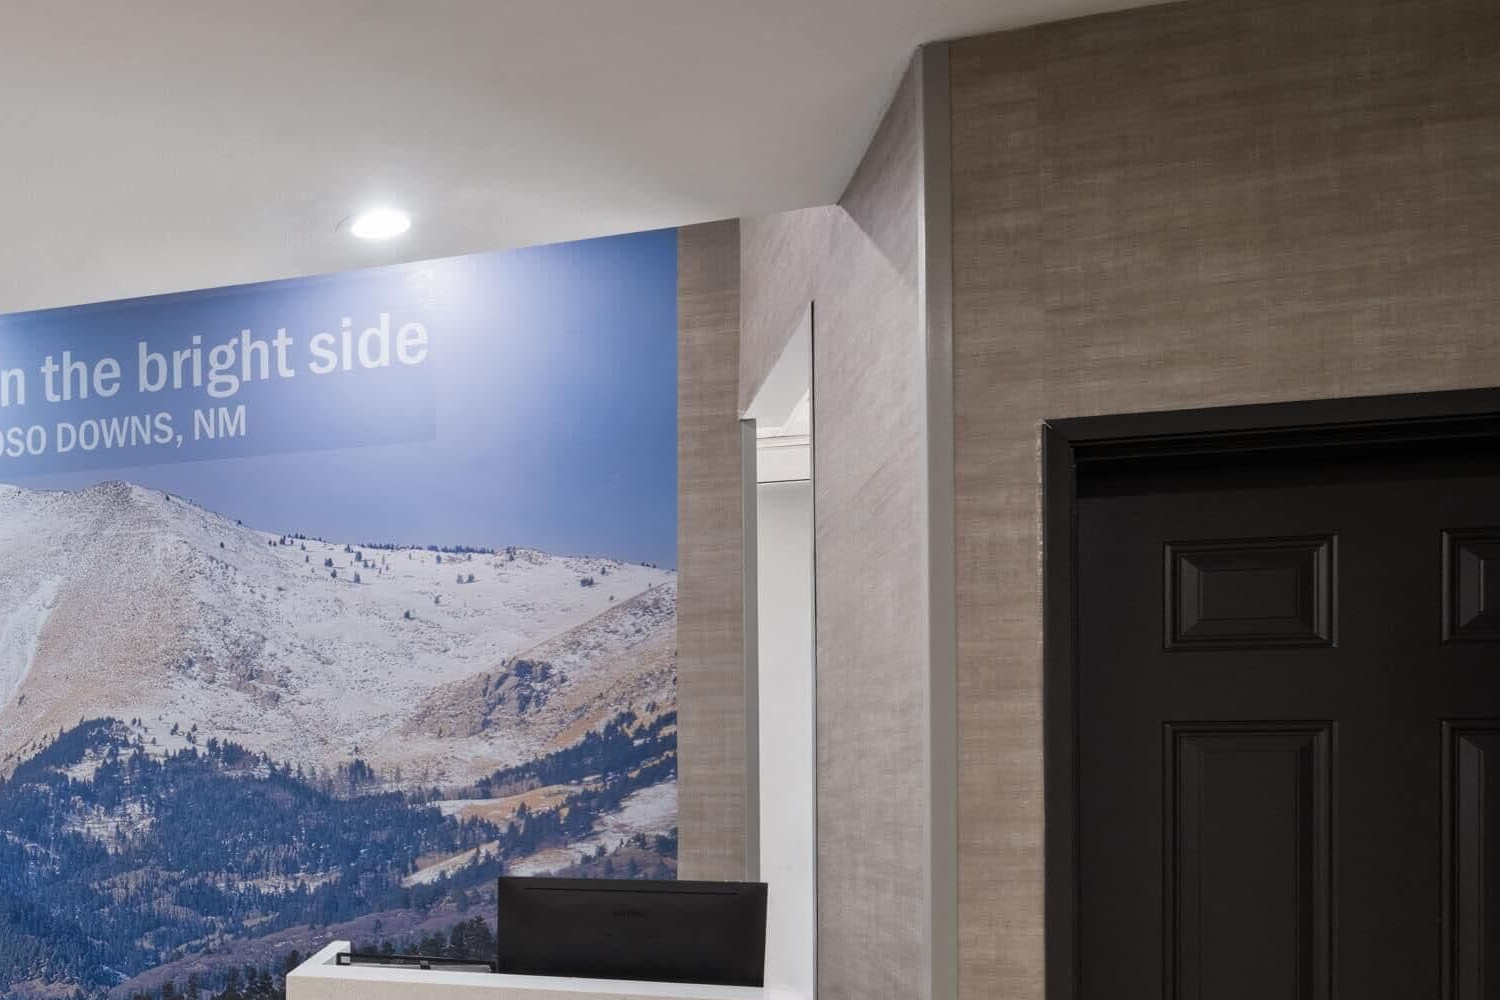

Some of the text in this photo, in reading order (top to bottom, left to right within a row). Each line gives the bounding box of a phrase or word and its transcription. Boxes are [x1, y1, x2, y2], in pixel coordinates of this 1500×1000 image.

[40, 351, 121, 402] the
[138, 328, 295, 398] bright
[308, 312, 428, 375] side
[57, 412, 183, 453] DOWNS,
[194, 405, 245, 440] NM
